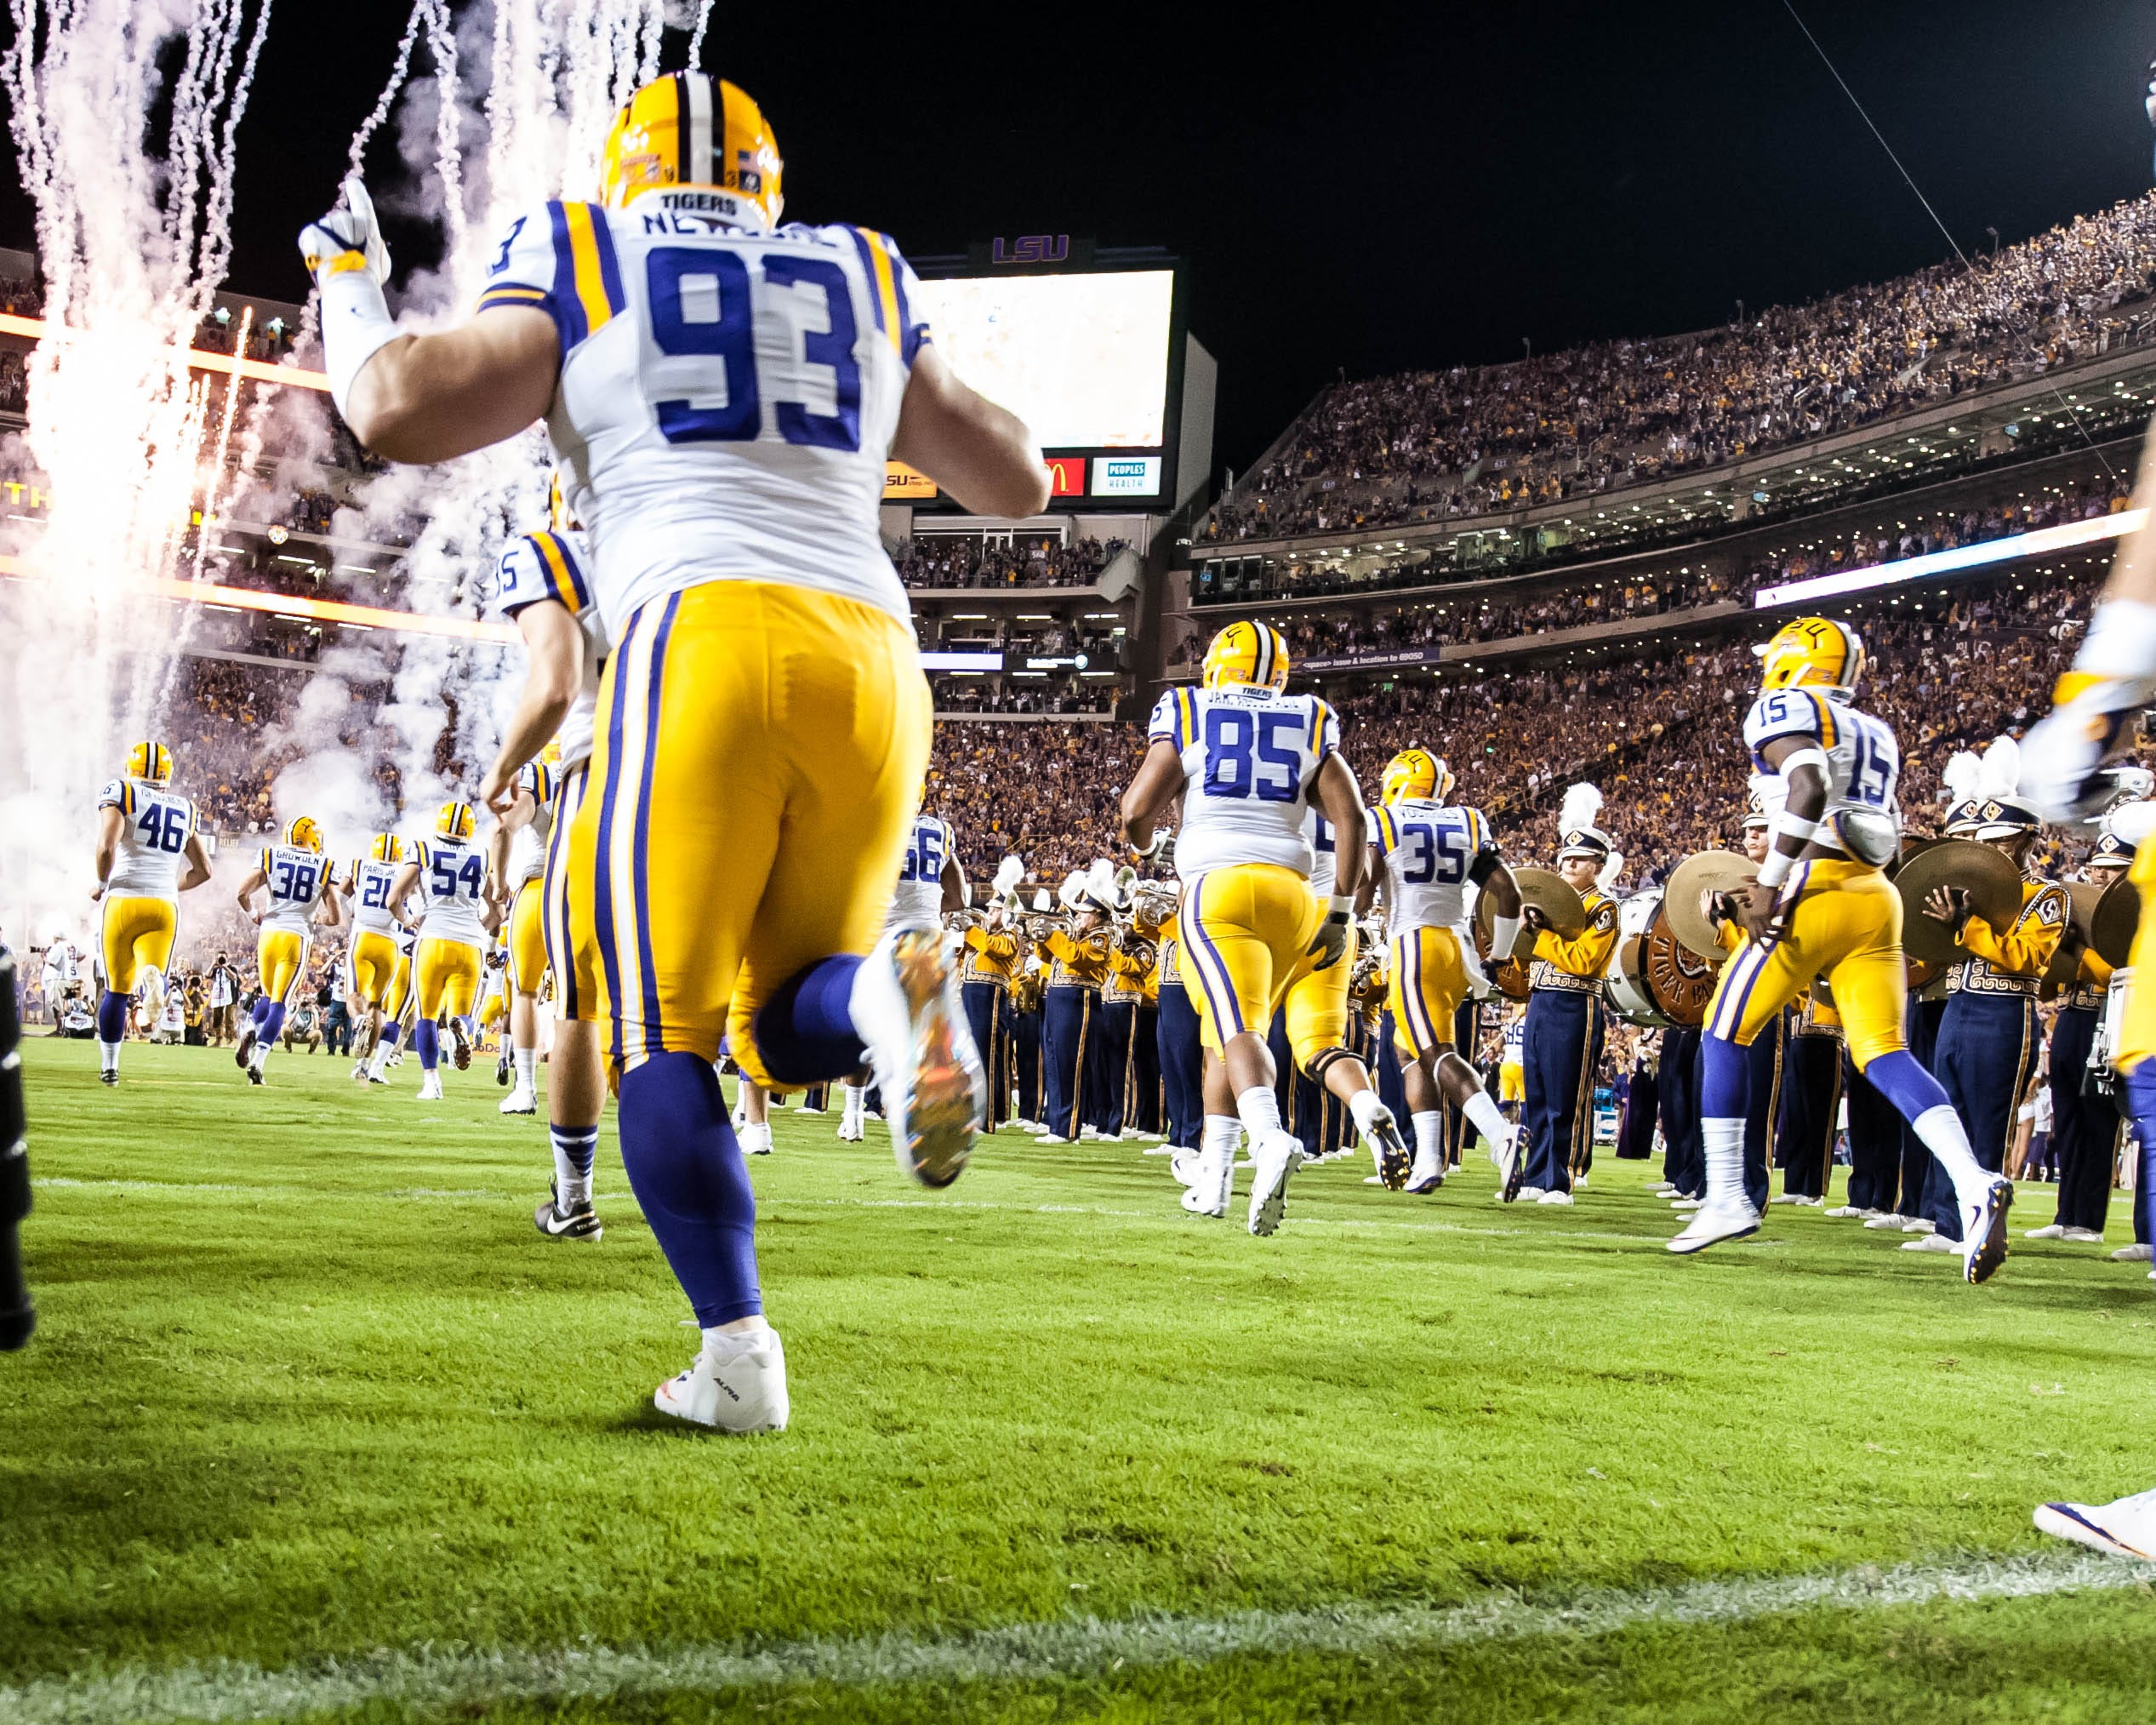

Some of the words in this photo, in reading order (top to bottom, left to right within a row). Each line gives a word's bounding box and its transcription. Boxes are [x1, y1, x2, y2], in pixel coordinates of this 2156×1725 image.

[661, 193, 737, 216] TIGERS
[992, 234, 1069, 265] LSU
[644, 246, 862, 453] 93
[1109, 465, 1144, 475] PEOPLES
[1109, 479, 1143, 488] HEALTH
[1360, 655, 1389, 665] location
[1242, 687, 1274, 699] TIGERS
[1760, 694, 1787, 728] 15
[1203, 709, 1304, 804] 85
[1845, 717, 1891, 806] 15
[138, 803, 186, 854] 46
[431, 850, 482, 900] 54
[1402, 823, 1464, 884] 35
[271, 861, 317, 904] 38
[1651, 935, 1686, 1006] TIGER
